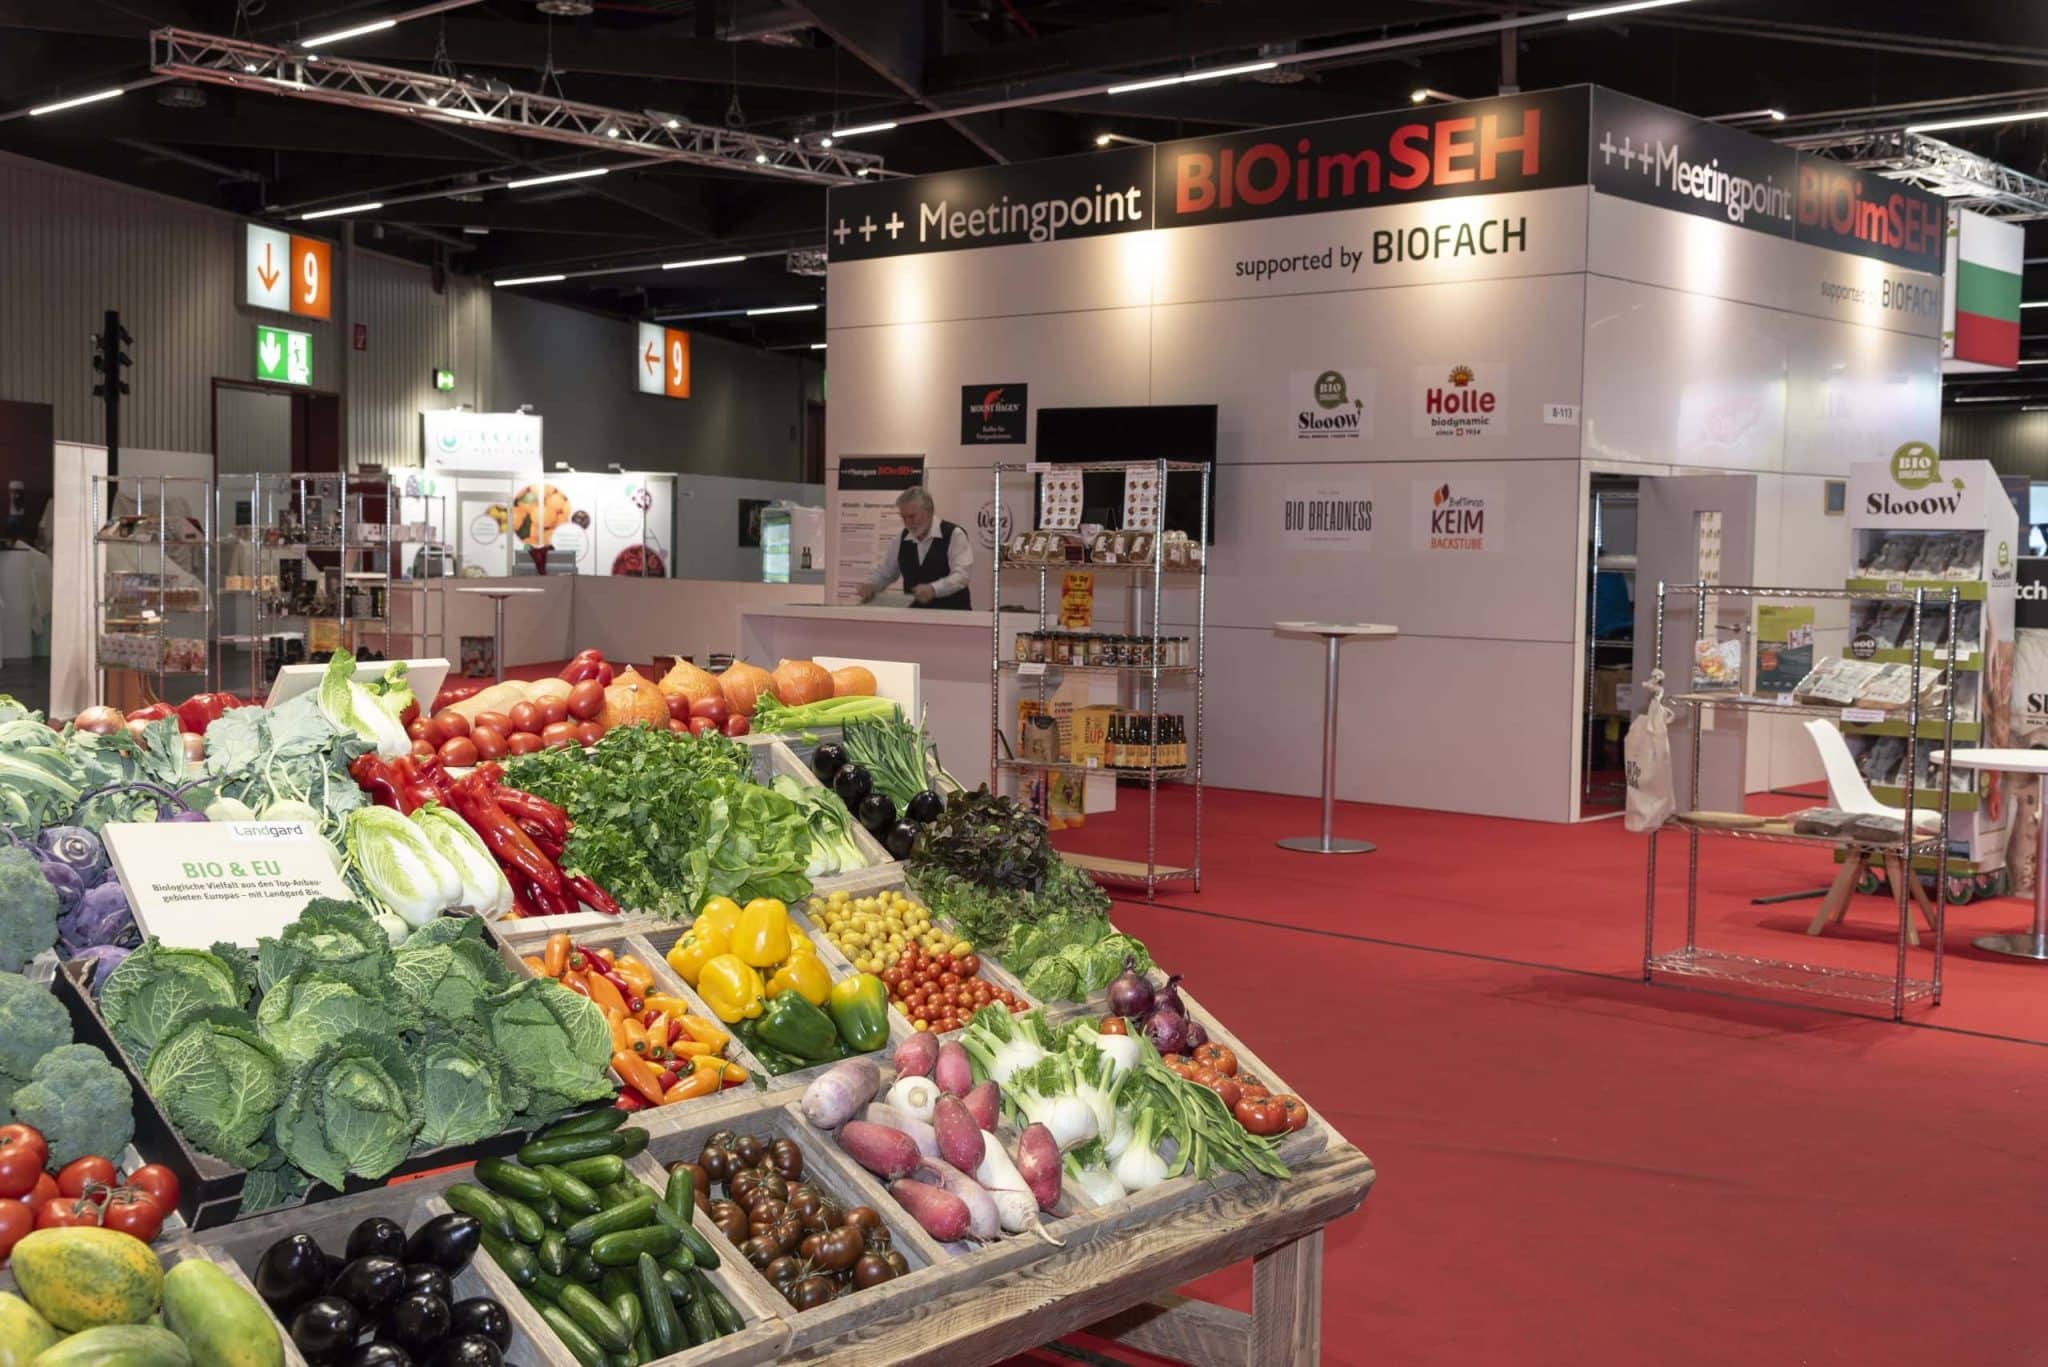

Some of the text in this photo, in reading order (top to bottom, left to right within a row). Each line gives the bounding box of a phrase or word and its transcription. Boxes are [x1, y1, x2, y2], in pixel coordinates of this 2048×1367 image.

[920, 185, 1142, 242] Meetingpoint
[1175, 109, 1541, 214] BIOimSEH
[1656, 140, 1791, 223] Meetingpoint
[1800, 166, 1941, 256] BIOimSEH
[1236, 217, 1526, 281] supported by BIOFACH
[303, 252, 318, 304] 9
[673, 340, 682, 387] 9
[1320, 383, 1342, 393] BIO
[1427, 387, 1495, 414] Holle
[1431, 416, 1489, 427] biodynamic
[1899, 456, 1931, 469] BIO
[1285, 501, 1372, 531] BIO BREADNESS
[1432, 509, 1484, 534] KEIM
[1431, 537, 1485, 550] BACKSTUBE
[234, 824, 304, 838] Landgard
[182, 860, 282, 879] BIO & EU
[152, 883, 205, 892] Biologische
[206, 881, 239, 890] Vielfalt
[275, 879, 322, 888] Top-Anbau-
[162, 894, 202, 903] gebieten
[204, 892, 239, 901] Europas
[263, 889, 304, 899] Landgard
[305, 888, 323, 896] Bio.
